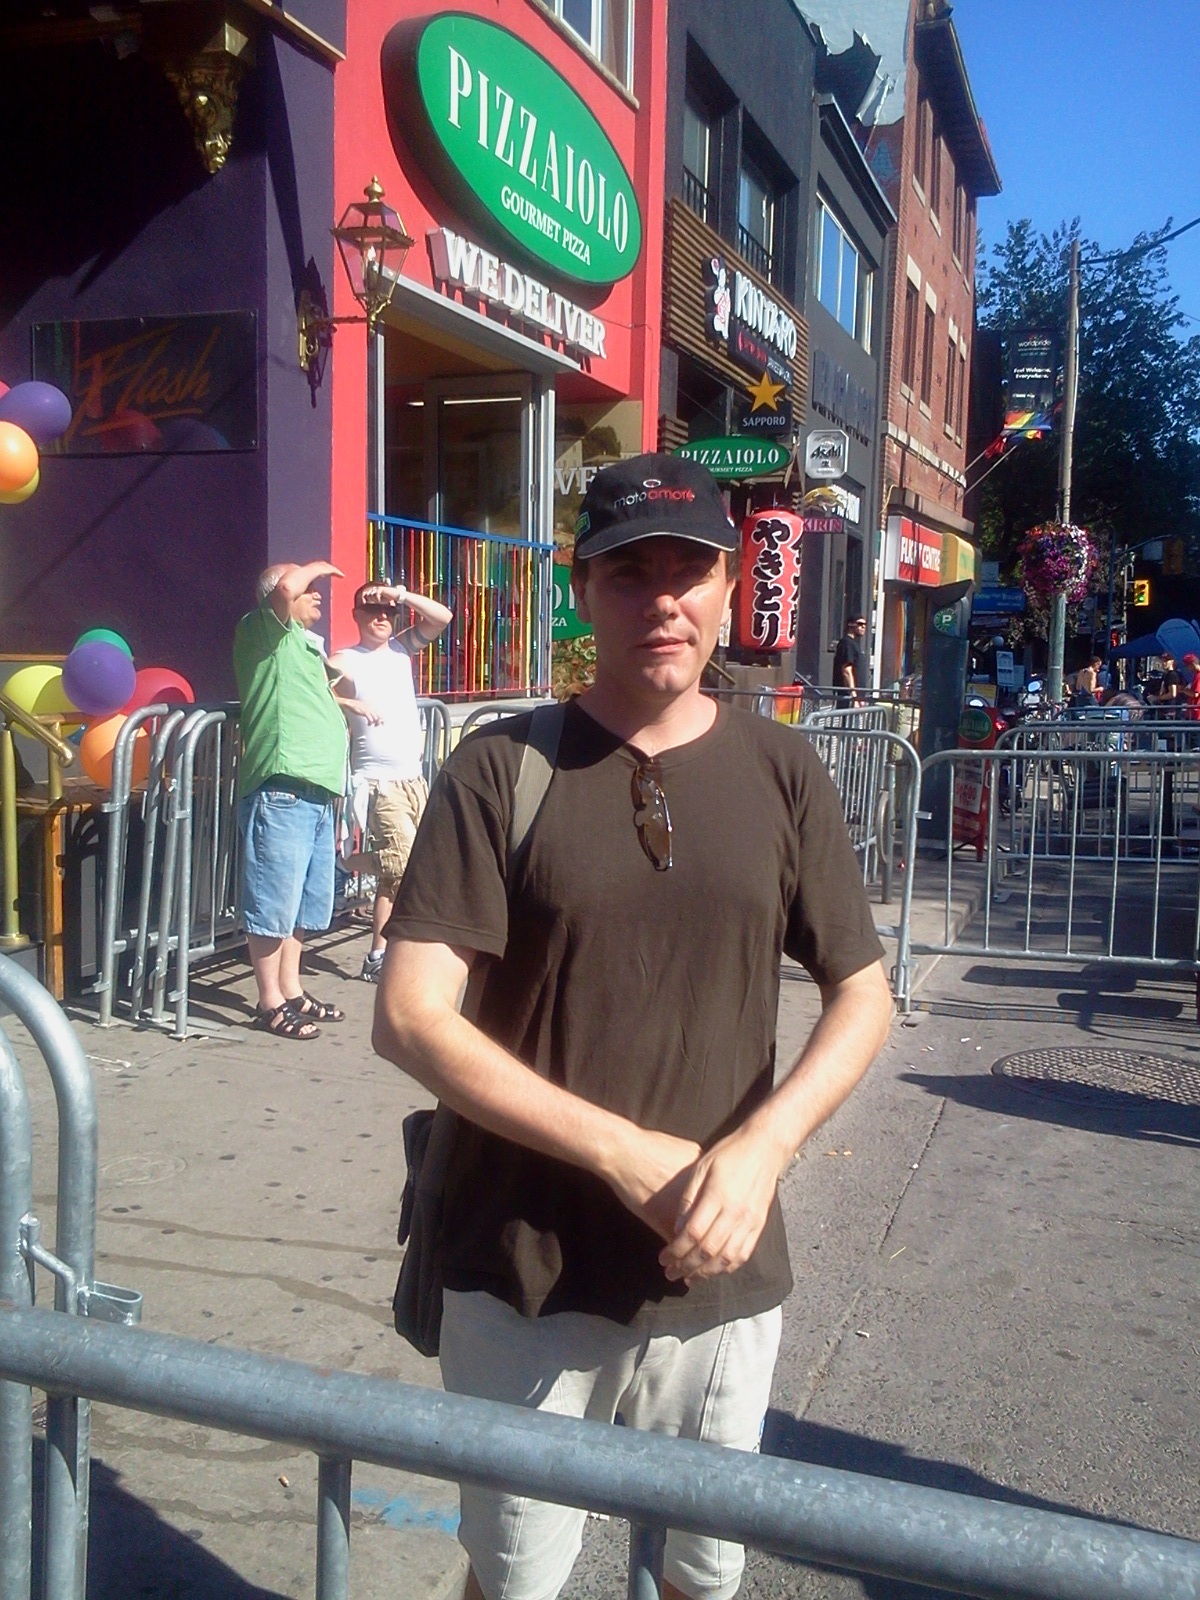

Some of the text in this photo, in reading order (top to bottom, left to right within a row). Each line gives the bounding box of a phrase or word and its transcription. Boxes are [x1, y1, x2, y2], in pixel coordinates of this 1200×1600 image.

[447, 45, 629, 254] PIZZAIOLO
[501, 185, 592, 266] GOURMET PIZZA
[440, 227, 607, 359] WE DELIVER
[65, 320, 222, 443] Flash
[742, 416, 786, 427] SAPPORO
[554, 466, 608, 495] VE
[803, 518, 844, 533] KIRIN
[751, 517, 792, 648] やきとり
[942, 614, 952, 624] P
